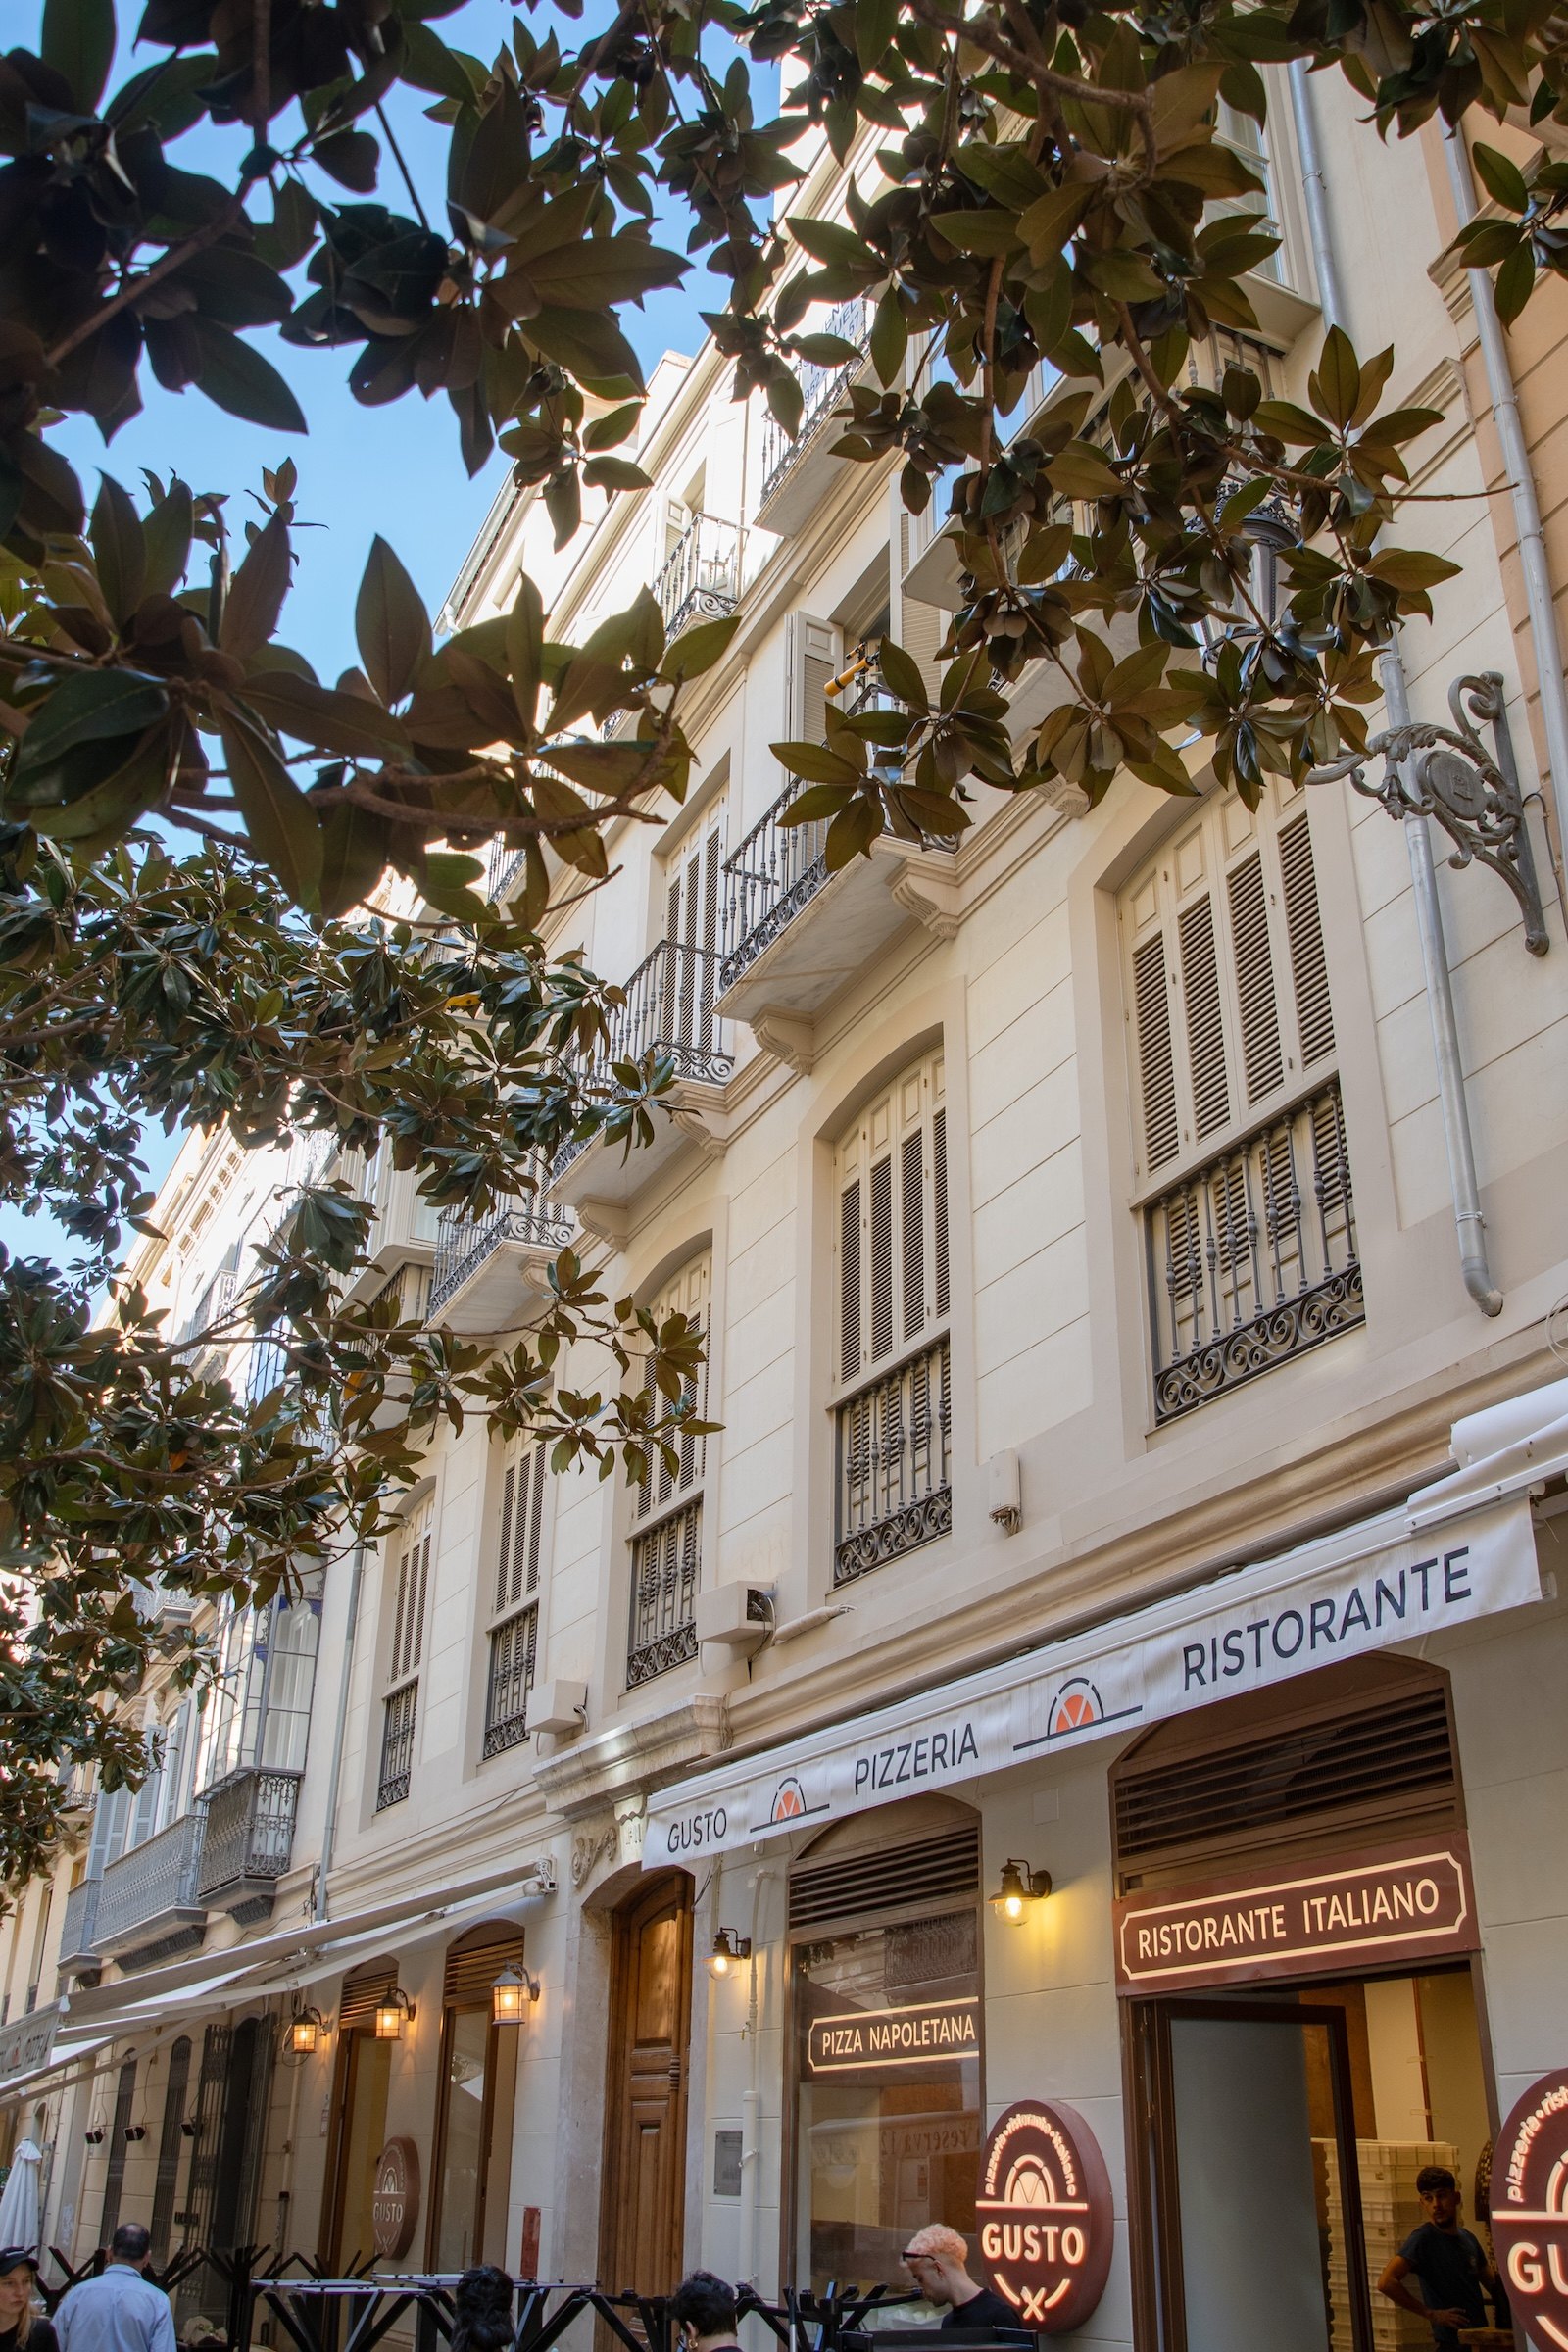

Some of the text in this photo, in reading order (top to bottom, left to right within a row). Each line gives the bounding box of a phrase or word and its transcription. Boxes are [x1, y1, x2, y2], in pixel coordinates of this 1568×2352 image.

[667, 1545, 1472, 1853] GUSTO PIZZERIA RISTORANTE
[1138, 1878, 1440, 1959] RISTORANTE ITALIANO
[822, 2014, 976, 2056] PIZZA NAPOLETANA
[984, 2132, 1007, 2196] pizzeria
[1005, 2113, 1052, 2134] ristorante
[1505, 2115, 1542, 2202] pizzeria
[373, 2201, 403, 2223] GUSTO
[982, 2223, 1085, 2265] GUSTO
